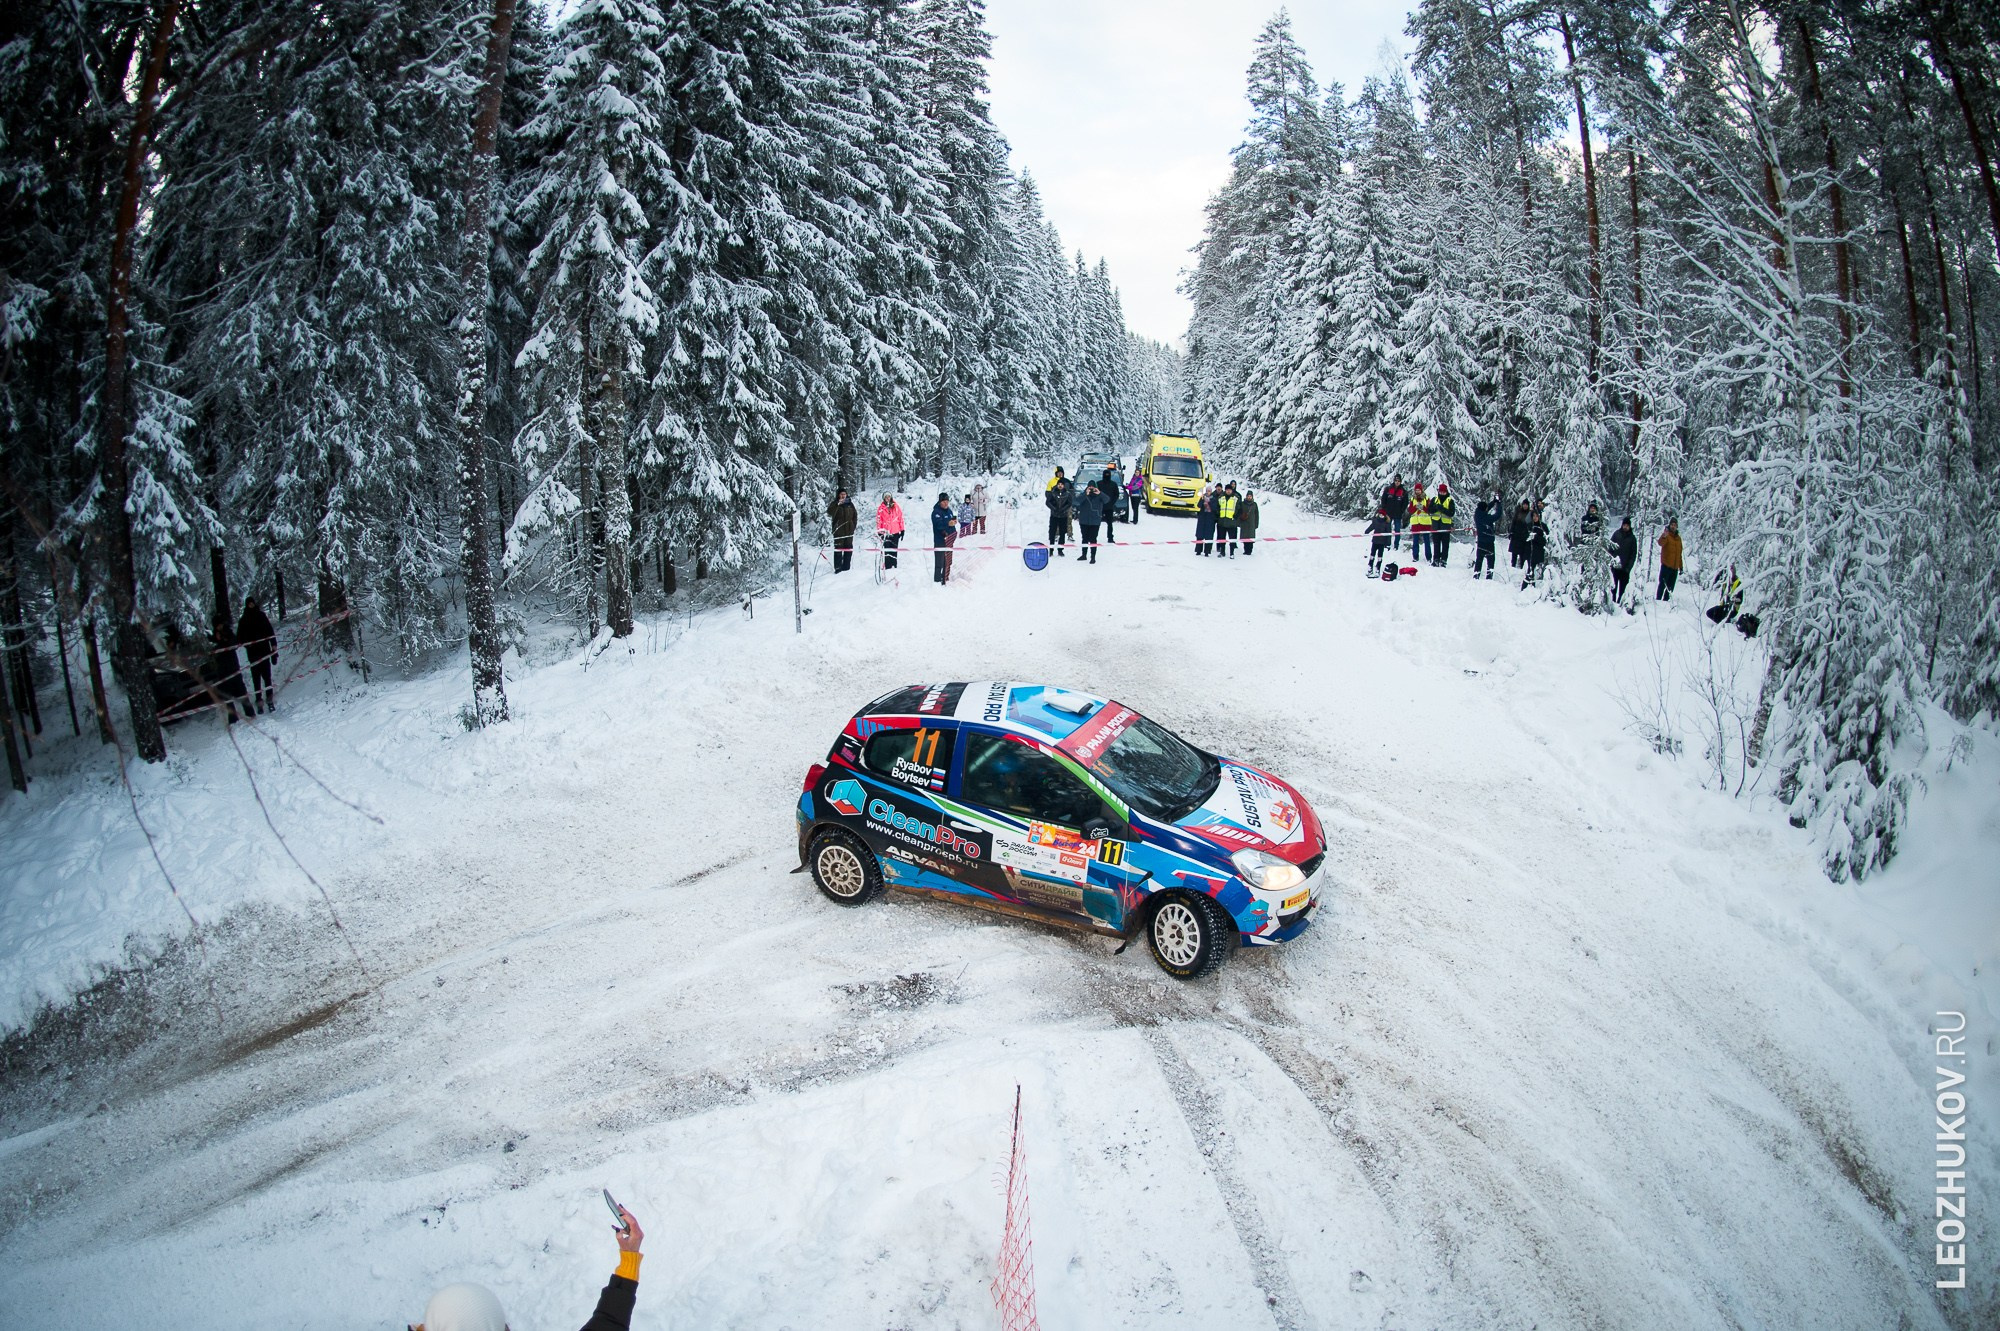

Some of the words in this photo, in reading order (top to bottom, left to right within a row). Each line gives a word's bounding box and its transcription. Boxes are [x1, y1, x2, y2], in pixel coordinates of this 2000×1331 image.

[912, 727, 941, 767] 11
[1086, 726, 1113, 750] РАЛЛИ
[891, 767, 930, 788] Boytsev
[896, 757, 932, 775] Ryabov
[1092, 760, 1115, 777] 11
[1230, 769, 1262, 828] SUSTAV.PRO
[868, 798, 981, 859] CleanPro
[866, 820, 978, 869] www.cleanprospb.ru
[1077, 842, 1096, 857] 24
[1103, 840, 1122, 865] 11
[885, 845, 955, 876] ADVAN
[1020, 879, 1079, 897] СИТИДРАЙВ
